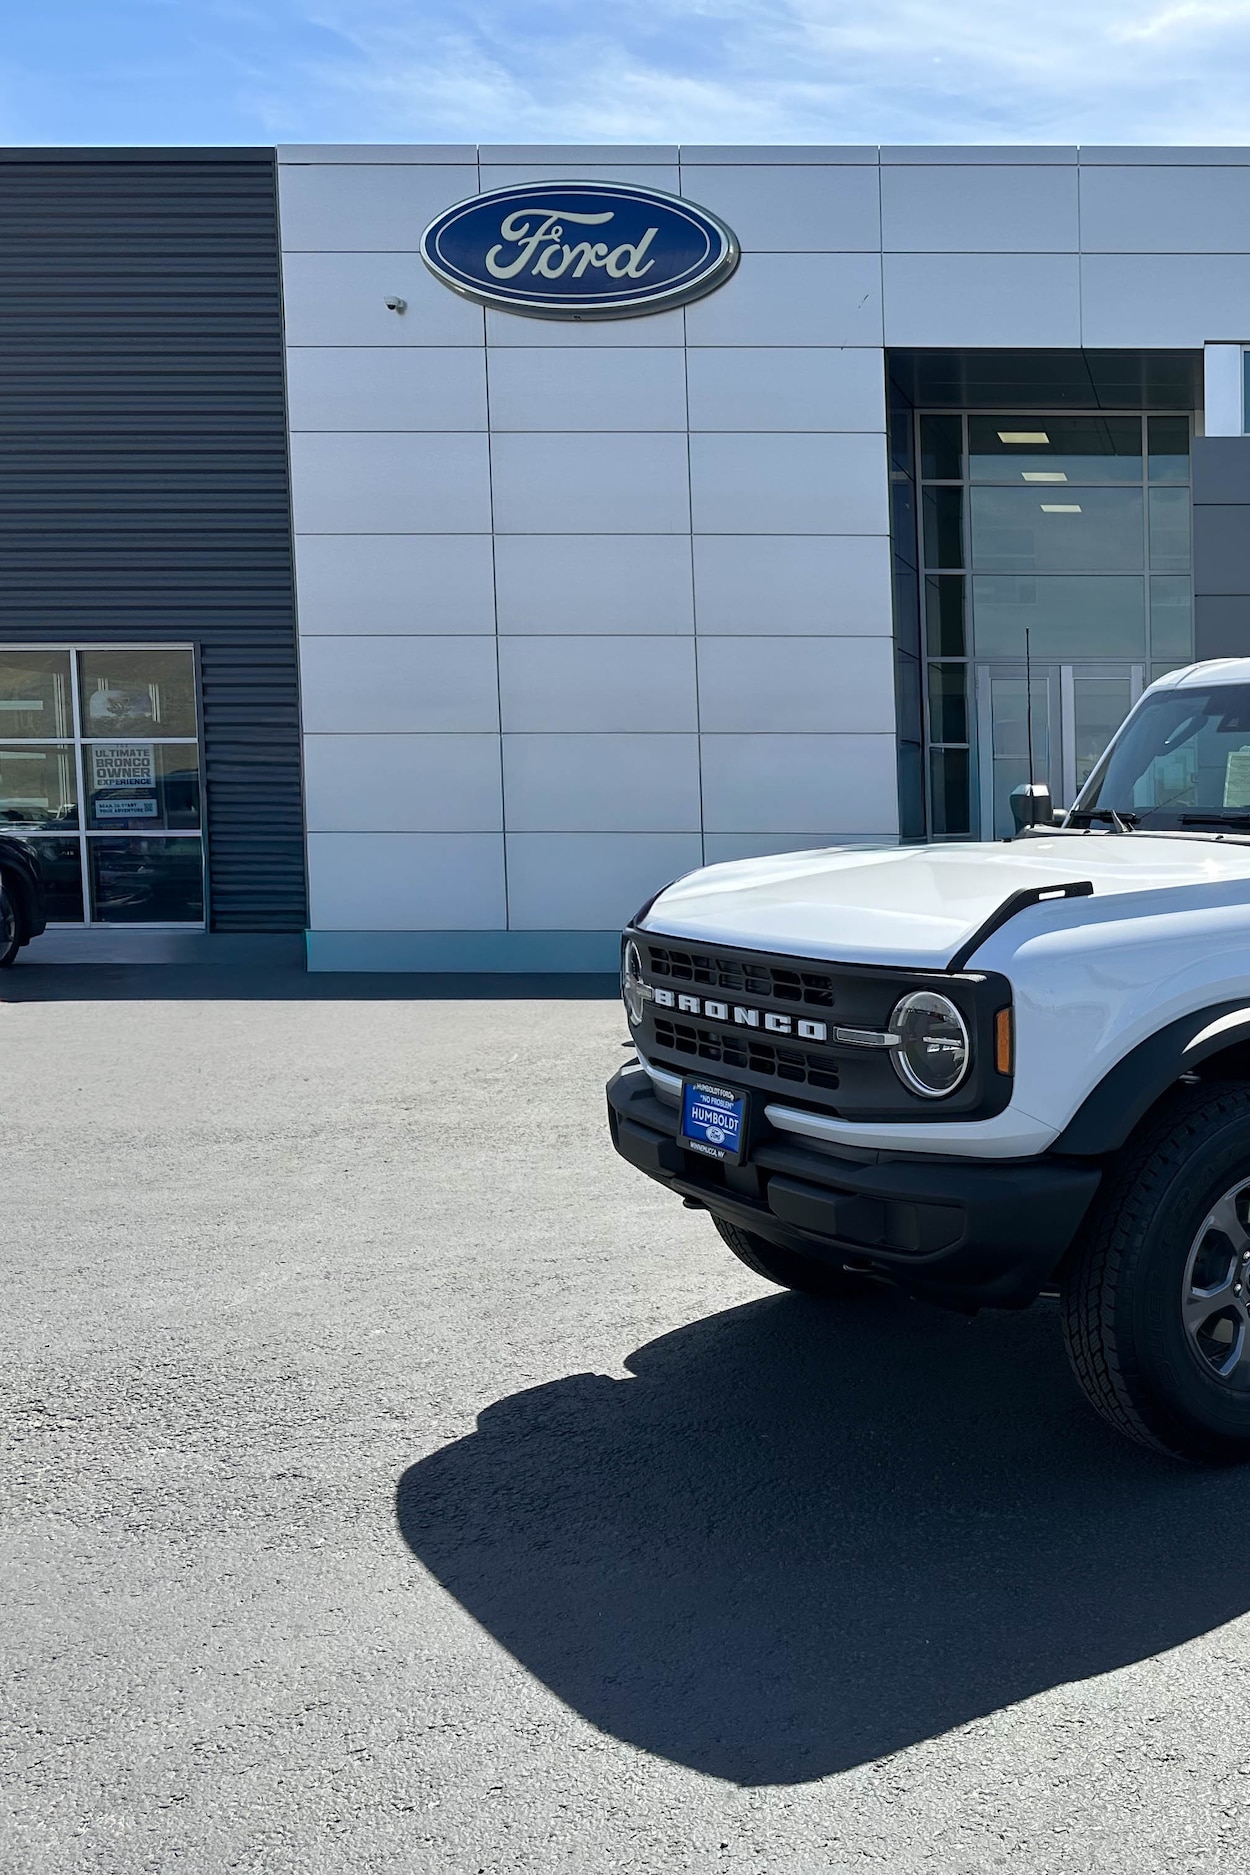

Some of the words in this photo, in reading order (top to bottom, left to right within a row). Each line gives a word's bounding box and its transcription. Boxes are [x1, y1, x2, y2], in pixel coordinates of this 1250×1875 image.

[486, 208, 659, 279] Ford
[95, 749, 150, 758] ULTIMATE
[96, 757, 151, 768] BRONCO
[96, 767, 151, 778] OWNER
[97, 778, 152, 786] EXPERIENCE
[655, 988, 827, 1041] BRONCO
[696, 1083, 720, 1096] HUMBOLDT
[691, 1106, 739, 1131] HUMBOLDT
